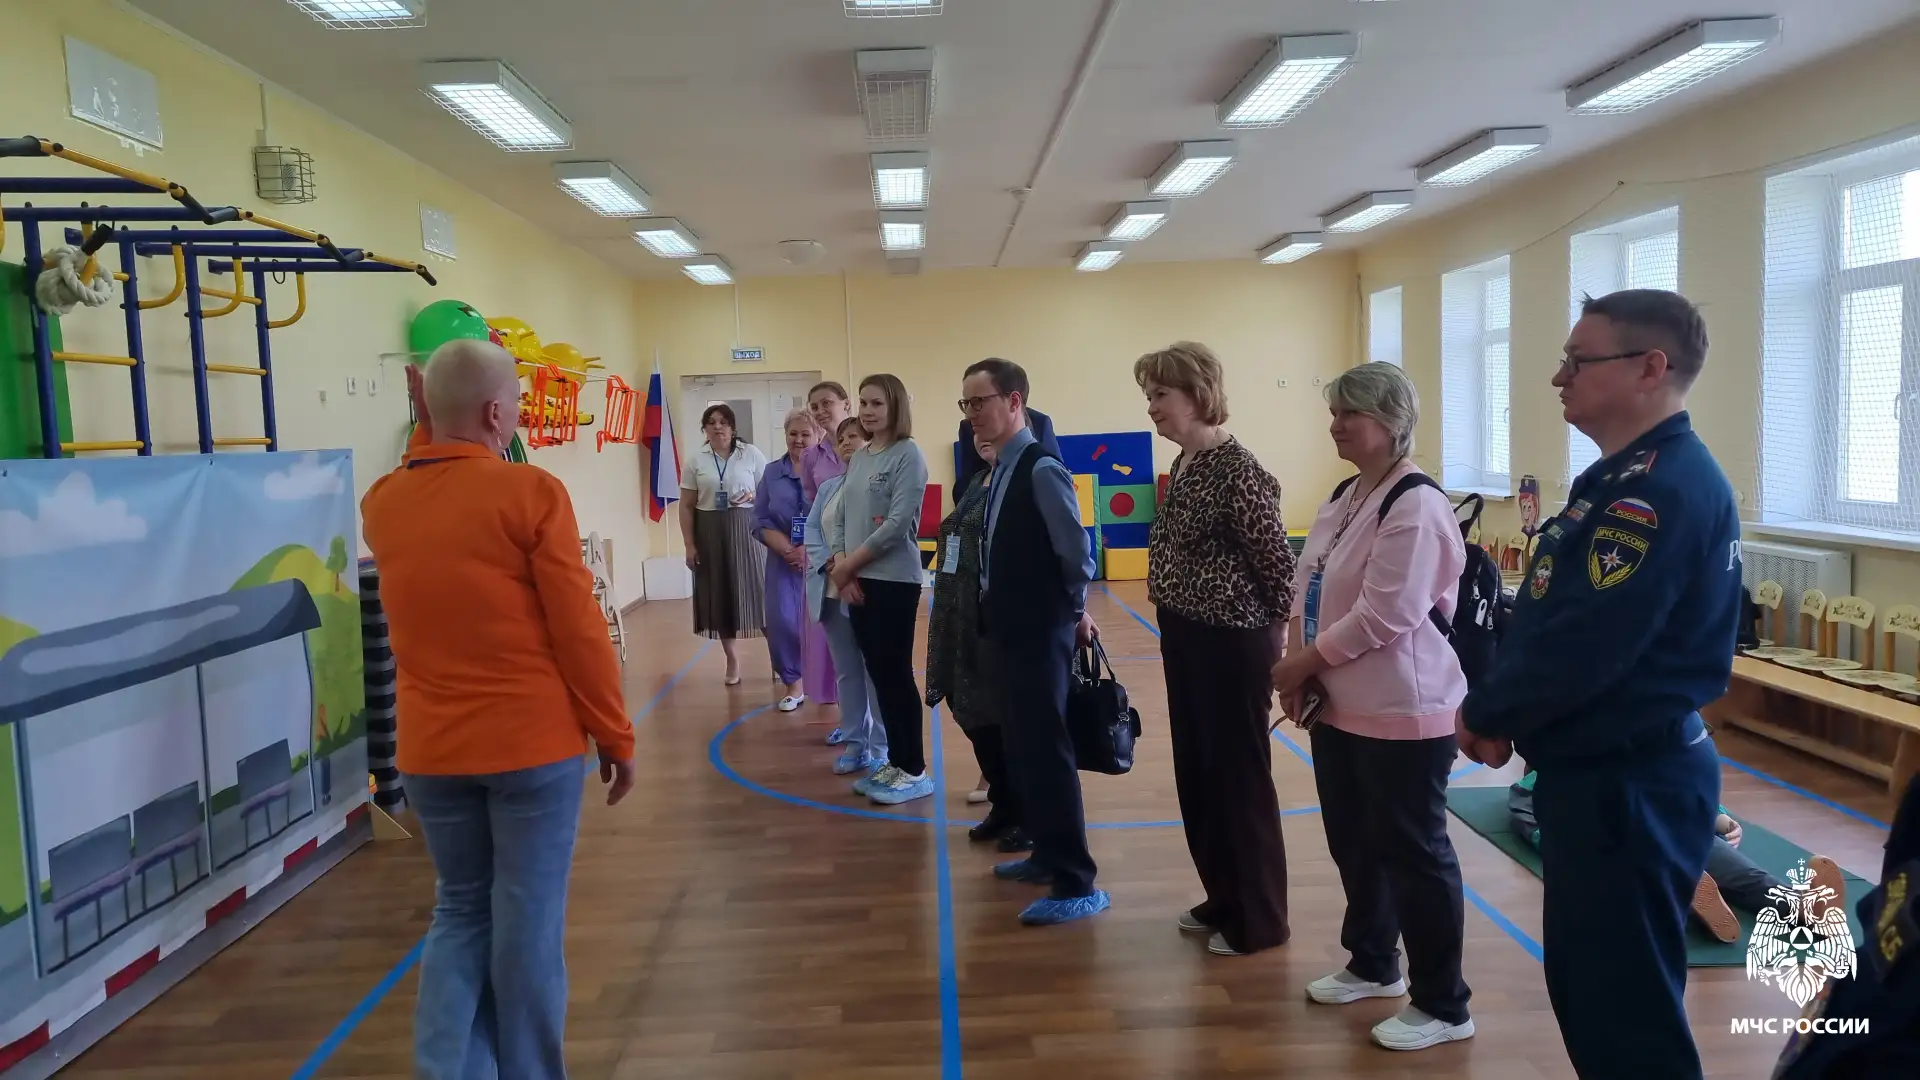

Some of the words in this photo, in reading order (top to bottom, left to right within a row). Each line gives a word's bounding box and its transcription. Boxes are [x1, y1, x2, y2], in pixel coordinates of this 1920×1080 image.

[734, 351, 761, 359] ВЫХОД
[1615, 509, 1648, 523] РОССИЯ
[1597, 528, 1614, 538] МЧС
[1614, 531, 1647, 551] РОССИИ
